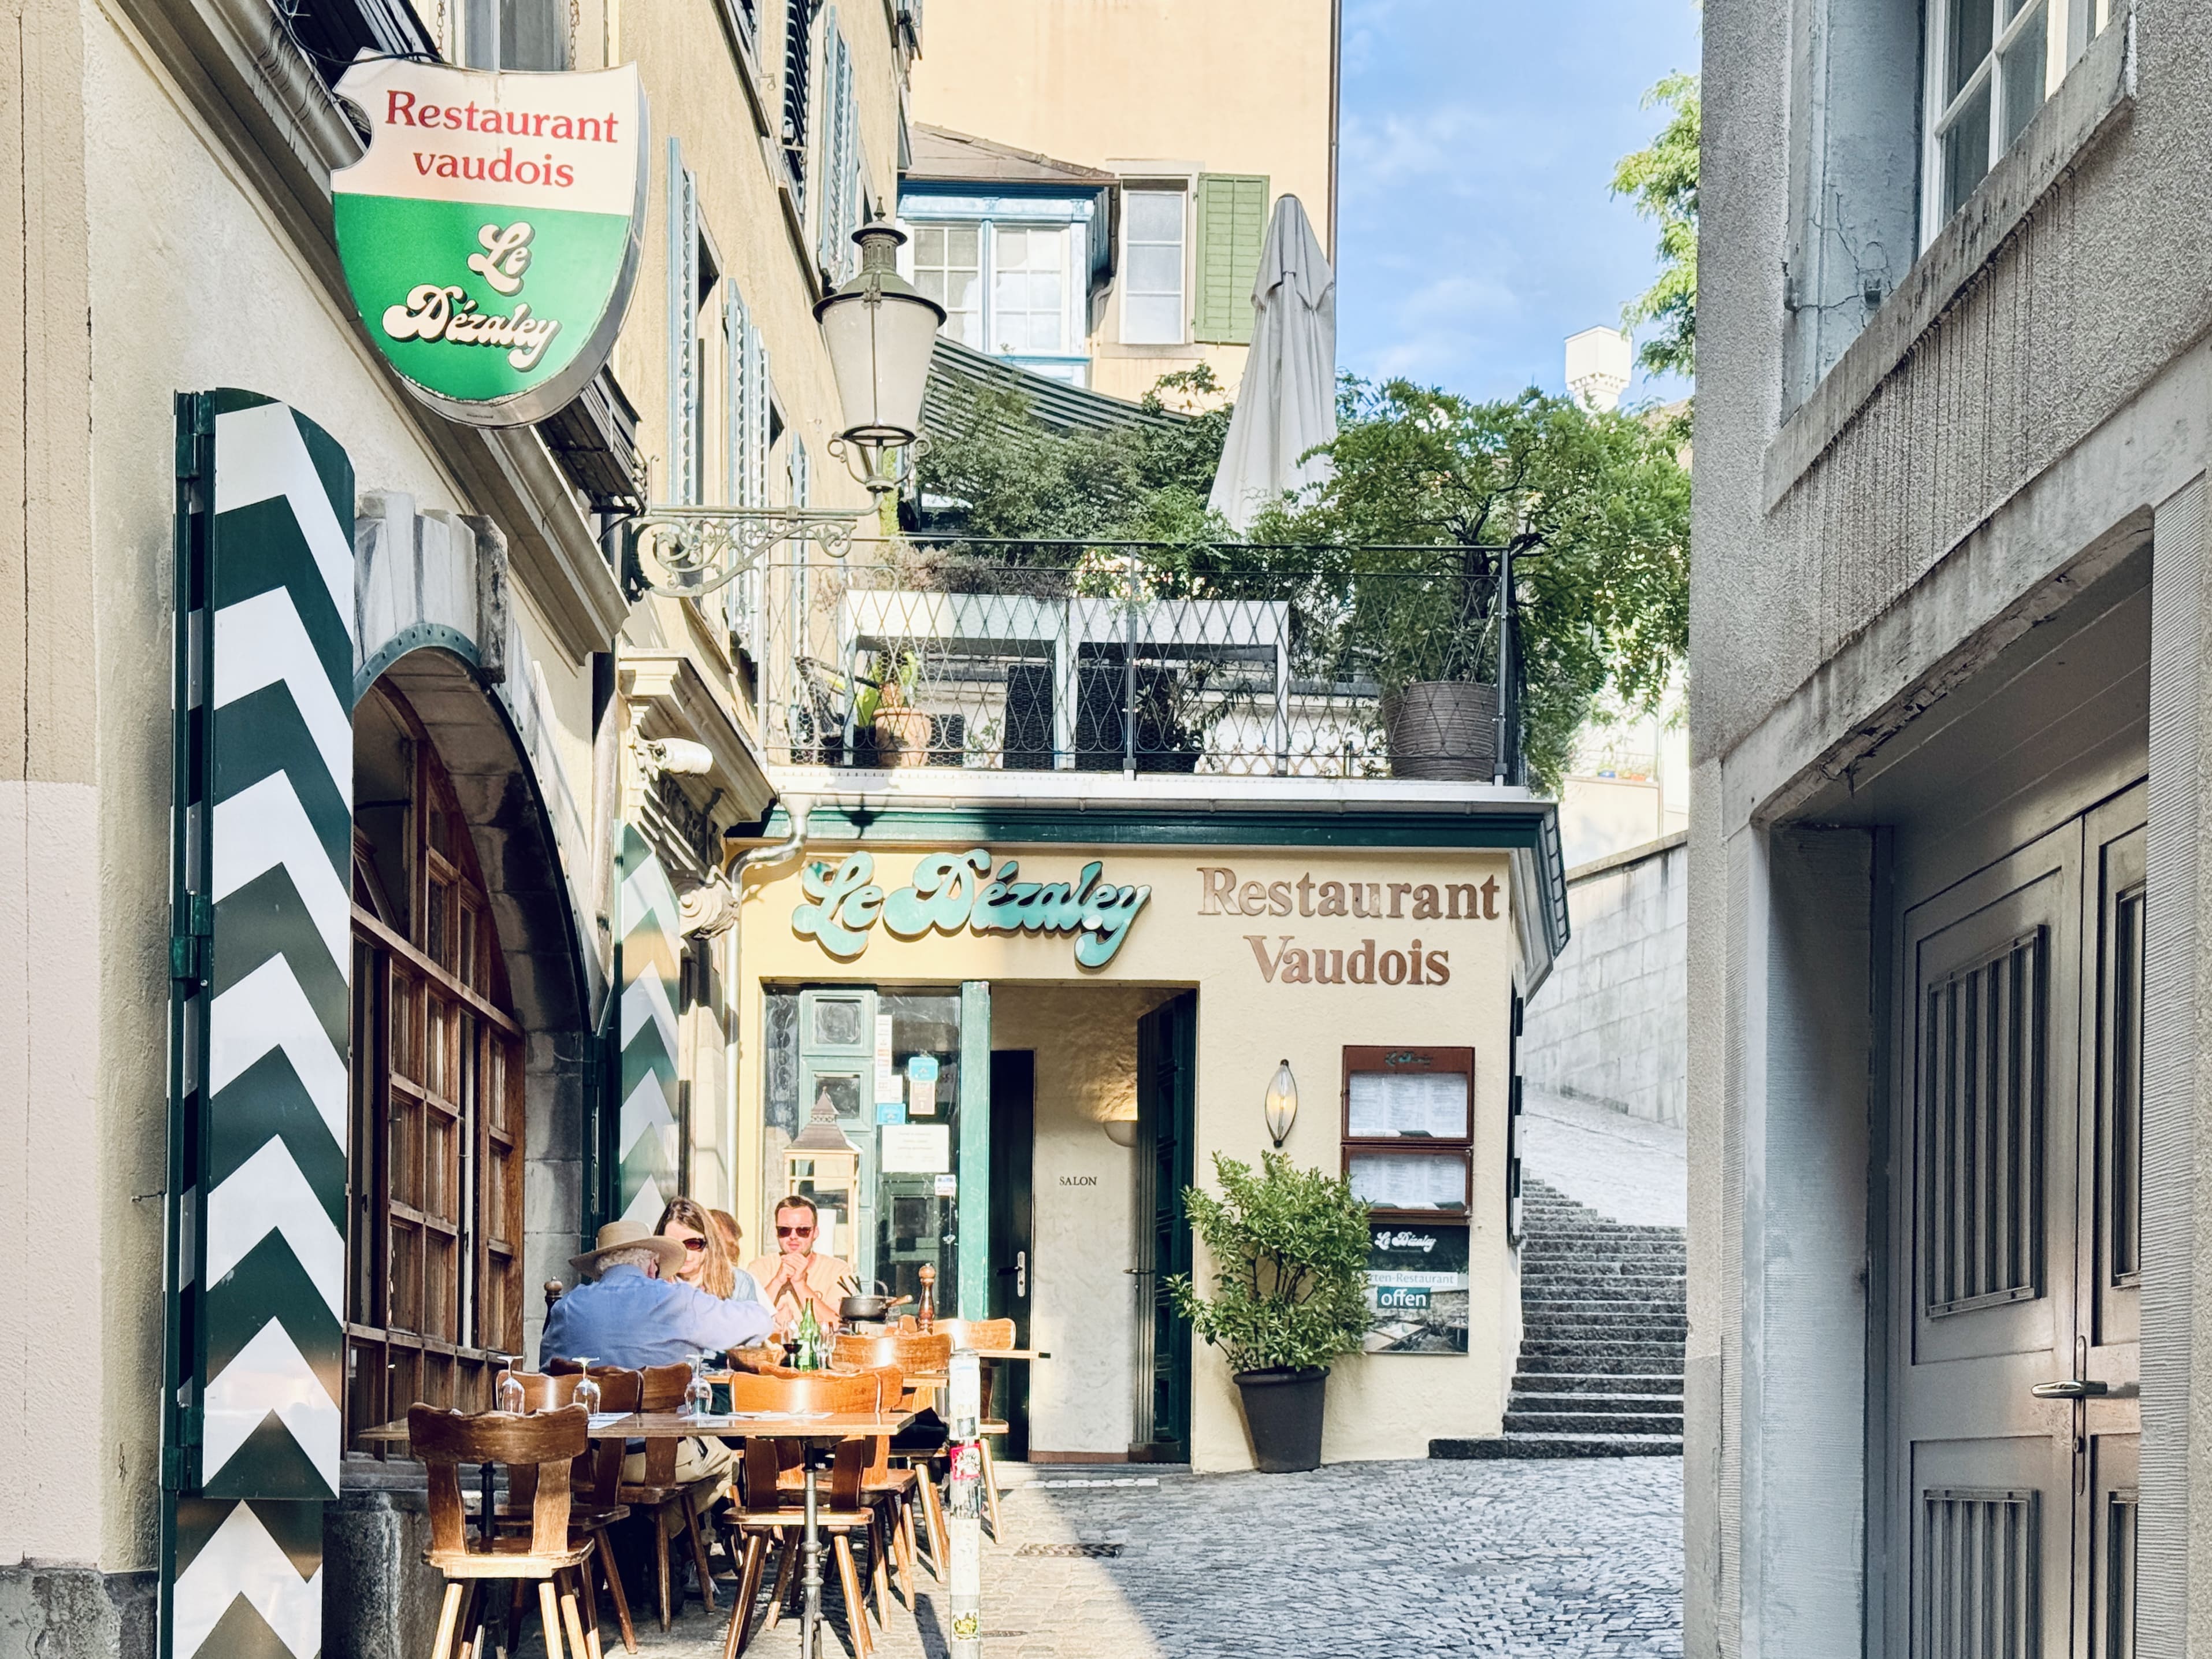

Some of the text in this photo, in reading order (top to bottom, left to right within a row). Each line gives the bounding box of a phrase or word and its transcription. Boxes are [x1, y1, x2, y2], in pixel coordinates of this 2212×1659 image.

[385, 89, 619, 144] Restaurant
[413, 147, 575, 188] vaudois
[466, 221, 535, 296] Le
[381, 283, 563, 373] Dézaley
[792, 848, 1152, 973] Le Dézaley
[1197, 867, 1500, 921] Restaurant
[1242, 934, 1451, 986] Vaudois
[1059, 1176, 1097, 1186] SALON
[1374, 1231, 1391, 1250] Le
[1380, 1289, 1427, 1307] offen
